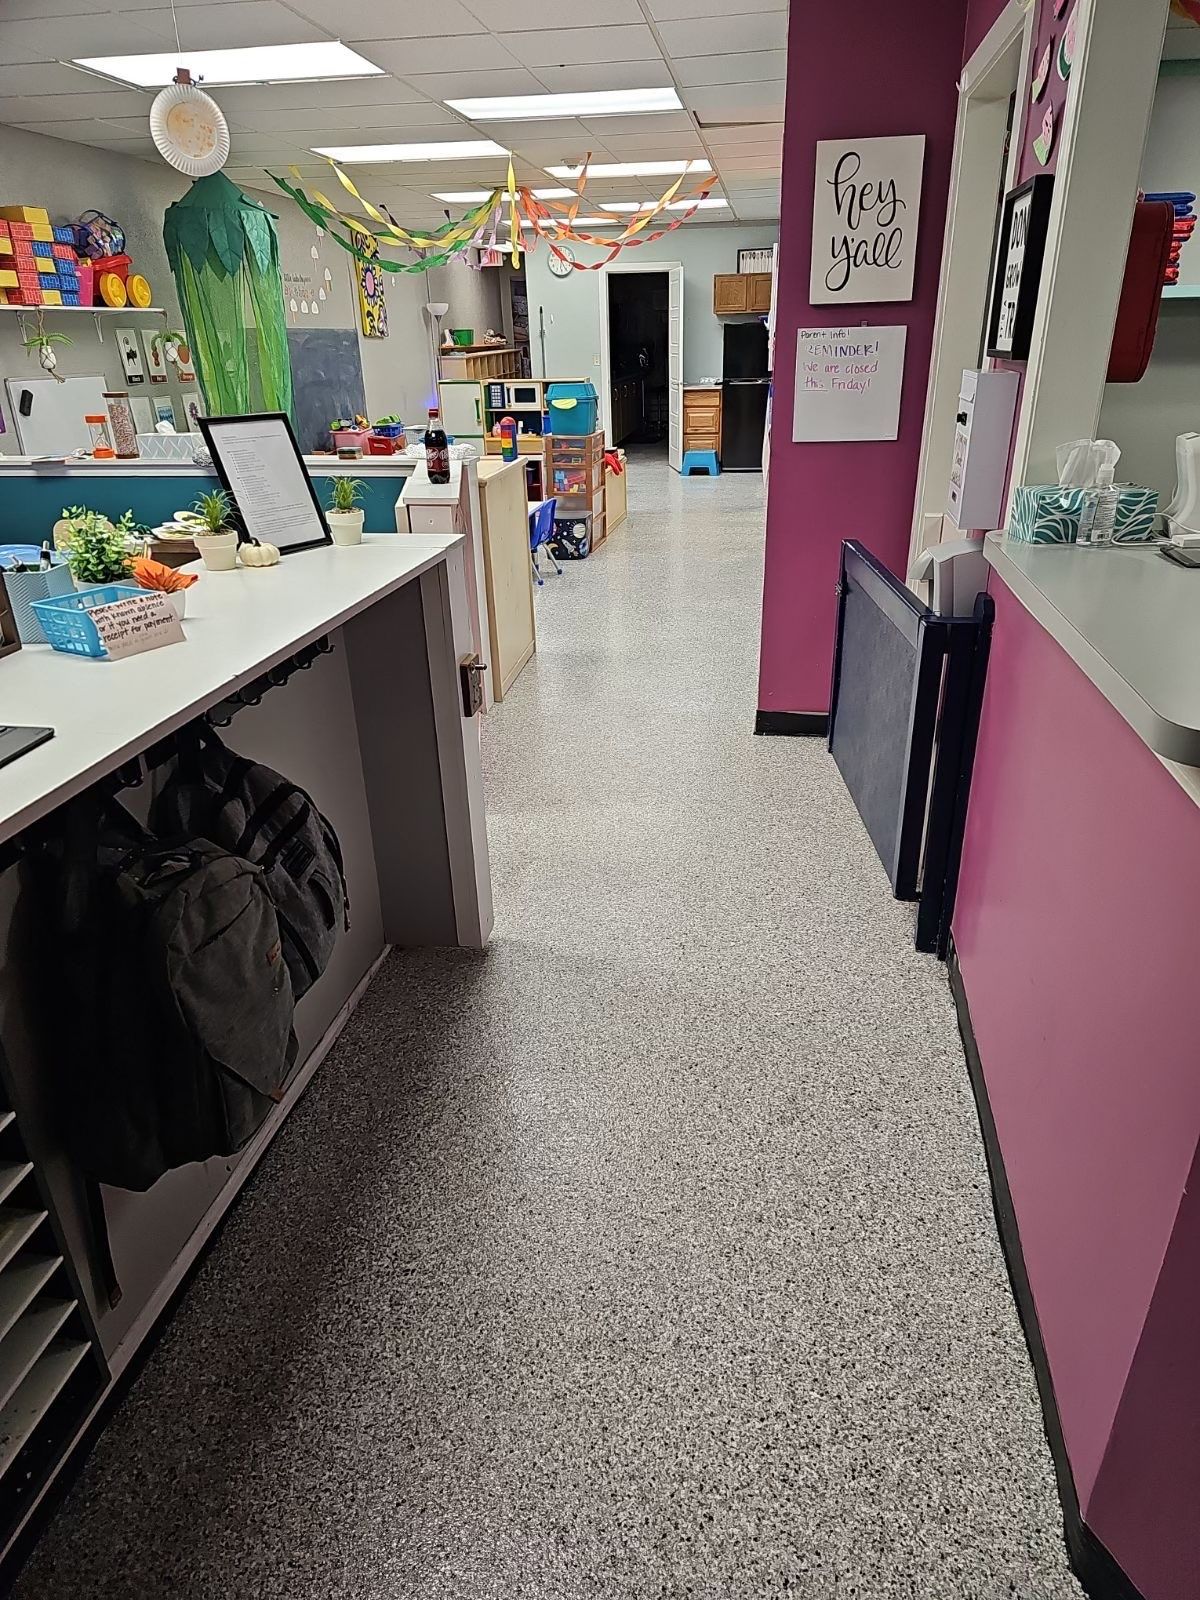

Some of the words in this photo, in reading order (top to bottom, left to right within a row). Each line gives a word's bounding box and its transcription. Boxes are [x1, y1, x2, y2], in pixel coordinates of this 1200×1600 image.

[827, 152, 906, 230] hey
[825, 228, 902, 291] y'all
[801, 330, 826, 339] Parent
[825, 364, 840, 373] are
[845, 360, 879, 374] closed
[831, 378, 871, 394] Friday!
[88, 604, 113, 616] Please
[116, 599, 138, 609] write
[144, 593, 164, 602] note
[96, 614, 110, 625] with
[111, 608, 136, 619] known
[98, 624, 106, 633] or
[116, 618, 130, 629] you
[132, 612, 148, 623] need
[103, 628, 129, 643] receipt
[131, 624, 142, 635] for
